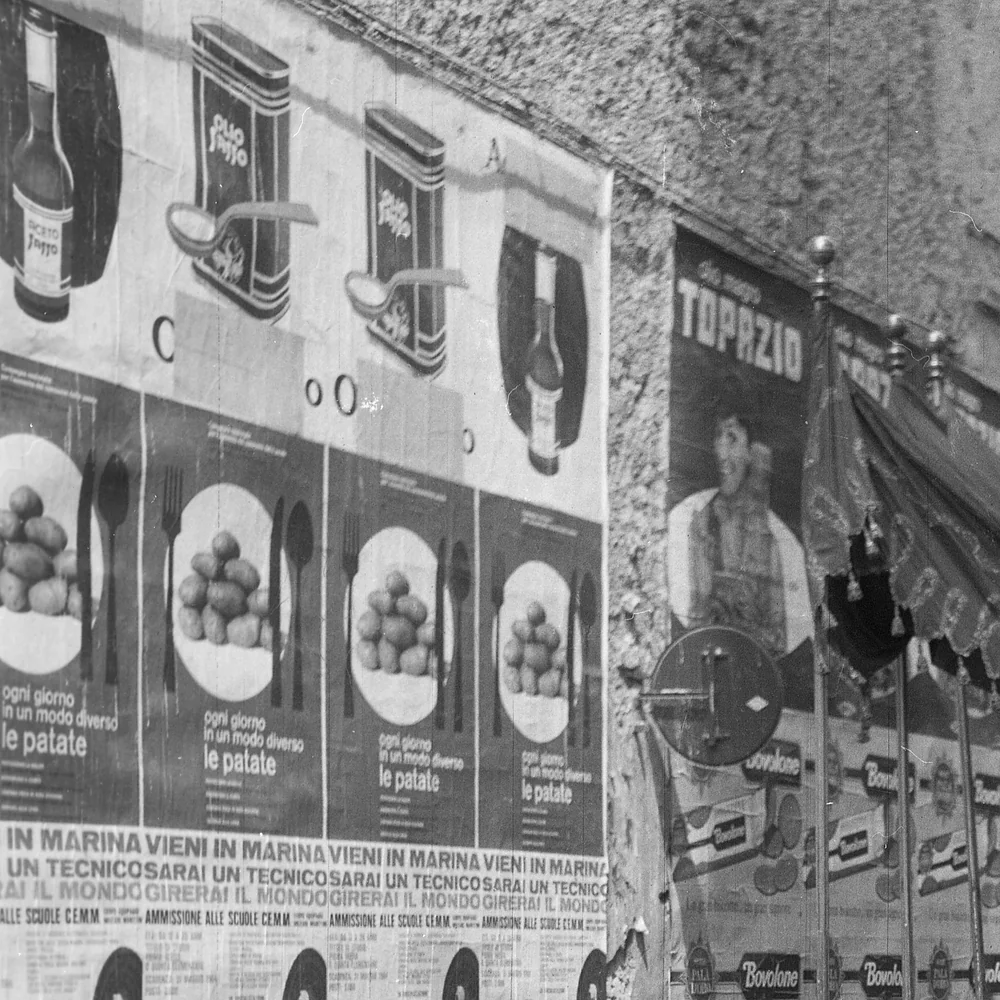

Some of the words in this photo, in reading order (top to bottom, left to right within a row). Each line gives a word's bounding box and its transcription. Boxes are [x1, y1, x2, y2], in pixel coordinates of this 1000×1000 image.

[677, 277, 803, 383] TOPAZIO
[2, 684, 31, 704] ogni
[34, 686, 75, 708] giorno
[2, 700, 14, 719] in
[16, 706, 33, 721] un
[36, 708, 73, 726] modo
[76, 709, 118, 732] diverso
[204, 709, 229, 729] ogni
[230, 710, 266, 732] giorno
[2, 721, 18, 750] le
[23, 727, 87, 757] patate
[204, 726, 214, 742] in
[216, 730, 230, 744] un
[232, 728, 264, 748] modo
[266, 731, 305, 754] diverso
[204, 743, 219, 770] le
[223, 748, 277, 776] patate
[379, 763, 393, 788] le
[395, 767, 440, 794] patate
[522, 777, 533, 801] le
[534, 781, 573, 805] patate
[7, 827, 33, 851] IN
[40, 828, 142, 854] MARINA
[145, 834, 208, 858] VIENI
[213, 838, 236, 859] IN
[242, 840, 326, 864] MARINA
[7, 857, 39, 878] UN
[46, 858, 142, 879] TECNICO
[328, 845, 383, 867] VIENI
[386, 849, 406, 868] IN
[410, 850, 480, 871] MARINA
[483, 853, 526, 873] VIENI
[529, 857, 547, 875] IN
[144, 861, 206, 882] SARAI
[212, 865, 241, 884] UN
[246, 867, 328, 887] TECNICO
[329, 870, 381, 888] SARAI
[386, 872, 408, 889] UN
[413, 873, 480, 892] TECNICO
[482, 876, 526, 893] SARAI
[529, 878, 549, 895] UN
[34, 880, 53, 900] IL
[60, 881, 142, 902] MONDO
[145, 883, 229, 904] GIRERAI
[235, 886, 252, 904] IL
[257, 887, 328, 907] MONDO
[329, 889, 399, 908] GIRERAI
[404, 891, 416, 909] IL
[421, 891, 480, 910] MONDO
[482, 893, 541, 911] GIRERAI
[545, 896, 556, 912] IL
[26, 907, 61, 925] SCUOLE
[145, 909, 202, 927] AMMISSIONE
[205, 911, 225, 927] ALLE
[228, 911, 258, 928] SCUOLE
[329, 913, 376, 929] AMMISSIONE
[379, 914, 395, 929] ALLE
[398, 914, 422, 929] SCUOLE
[482, 915, 522, 930] AMMISSIONE
[742, 960, 799, 989] Bovolone
[864, 962, 903, 986] Bovolo
